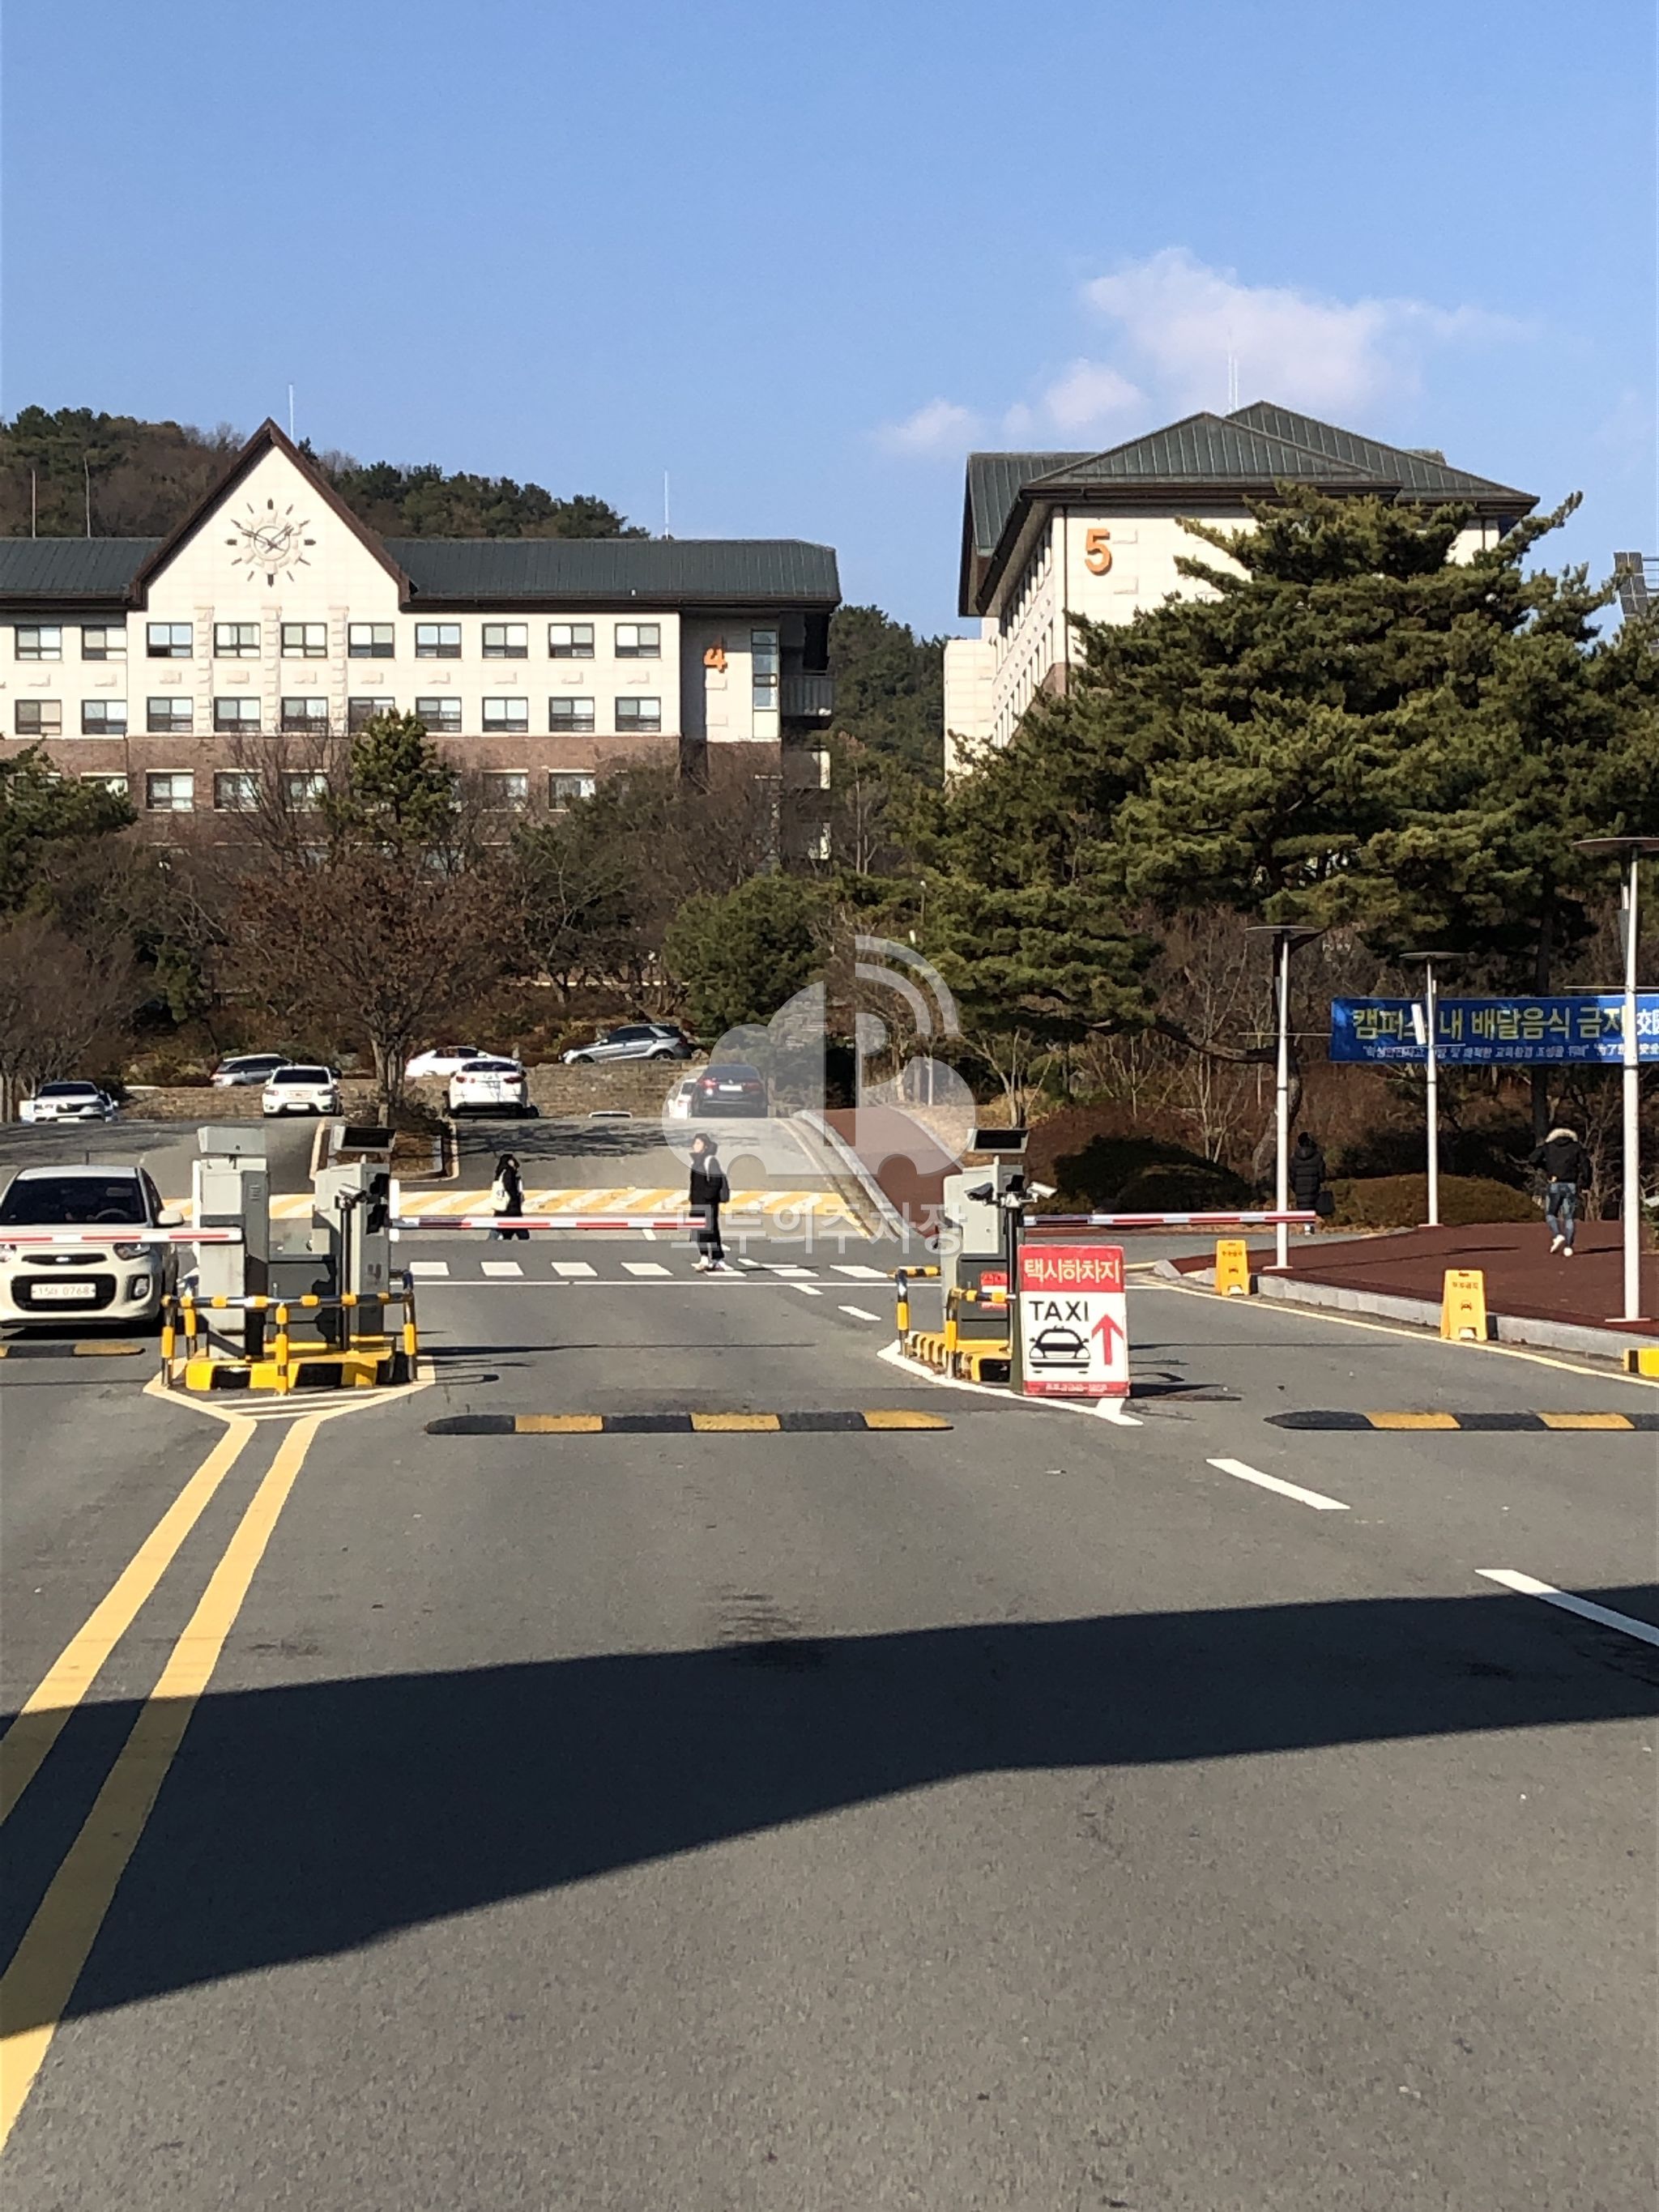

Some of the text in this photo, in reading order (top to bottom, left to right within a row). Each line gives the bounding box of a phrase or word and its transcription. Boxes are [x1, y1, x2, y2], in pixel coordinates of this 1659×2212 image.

[1085, 528, 1112, 576] 5
[702, 635, 728, 673] 4
[1439, 1008, 1463, 1041] 내
[1470, 1007, 1571, 1042] 배달음식
[1576, 1005, 1627, 1039] 금지
[1023, 1257, 1120, 1284] 택시하차지
[1028, 1300, 1090, 1322] TAXI
